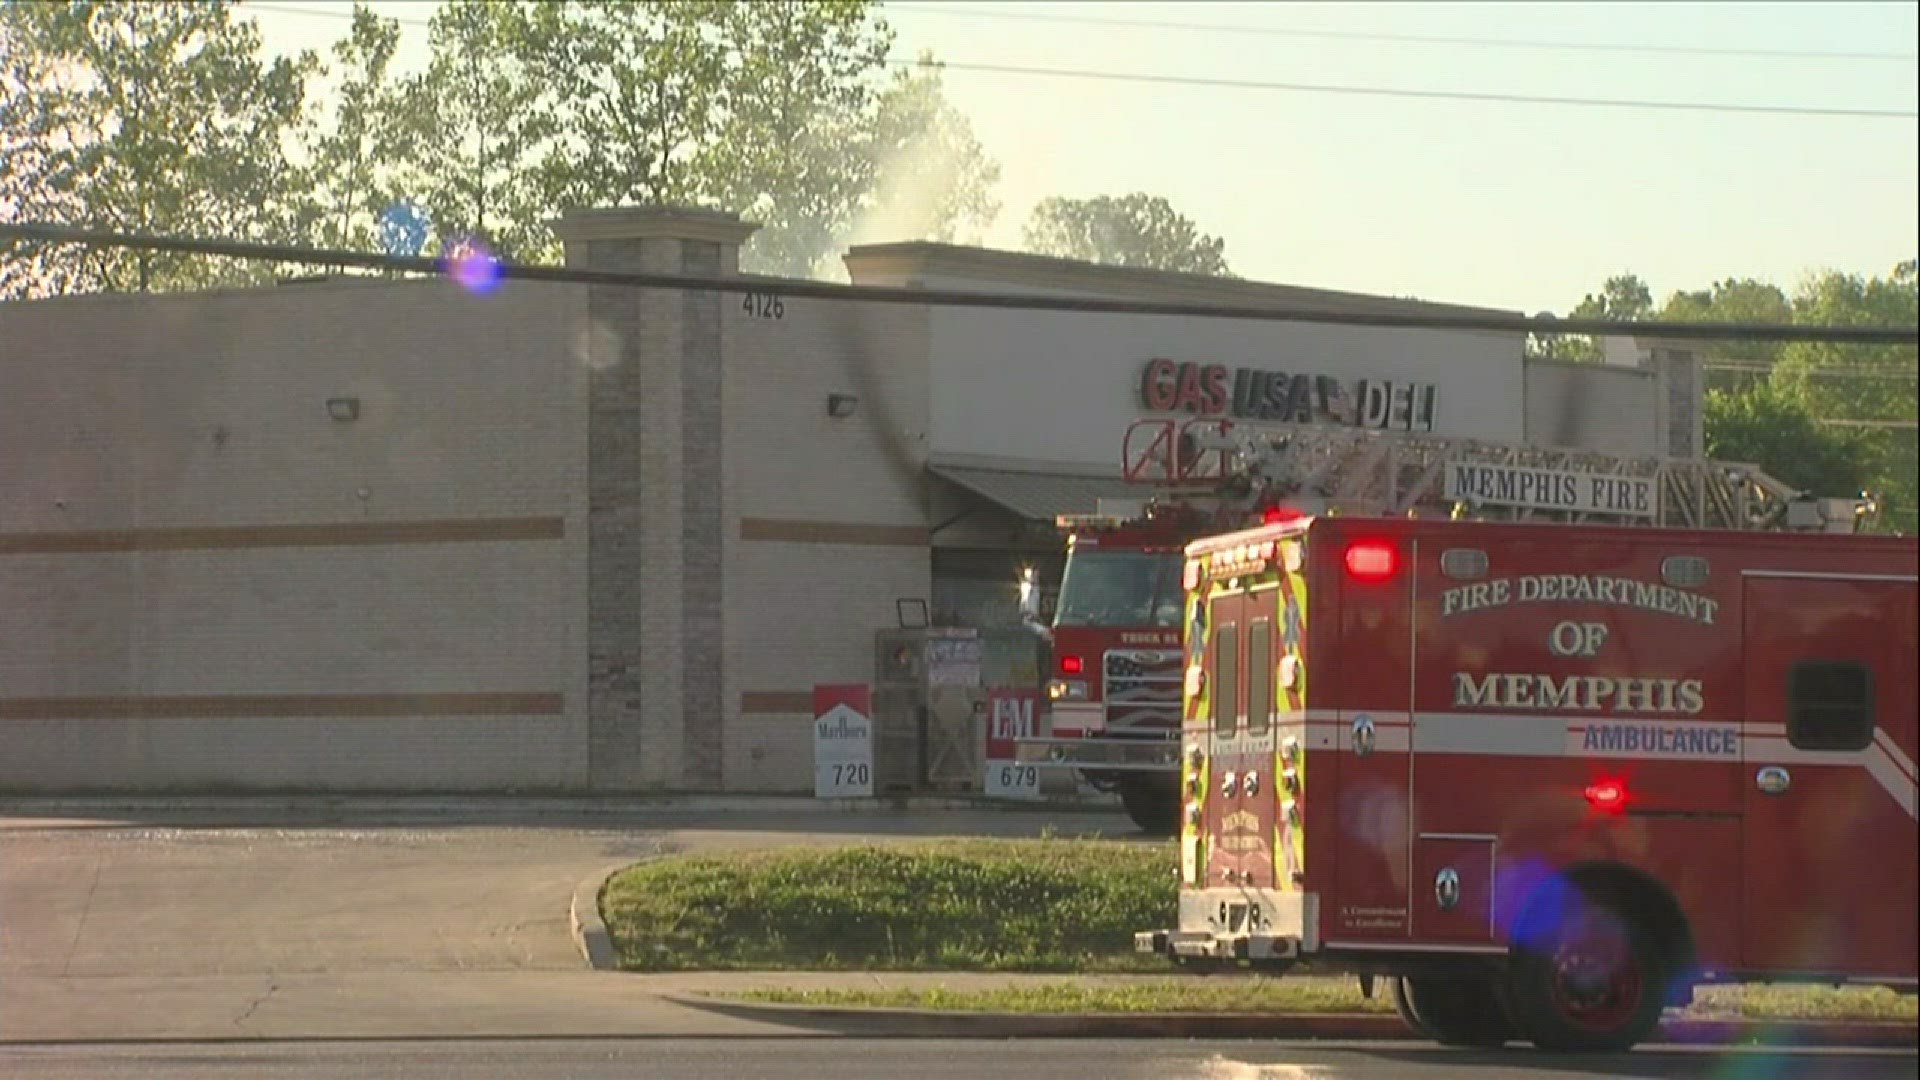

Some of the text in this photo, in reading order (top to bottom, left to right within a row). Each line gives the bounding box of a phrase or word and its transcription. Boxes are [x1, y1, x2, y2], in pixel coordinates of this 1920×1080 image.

[742, 291, 784, 319] 4126
[1141, 358, 1439, 432] GAS USA DELI
[1455, 466, 1649, 512] MEMPHIS FIRE
[1442, 574, 1719, 625] FIRE DEPARTMENT
[1550, 620, 1608, 656] OF
[1454, 671, 1705, 714] MEMPHIS
[1583, 724, 1738, 755] AMBULANCE
[832, 764, 869, 786] 720
[1001, 766, 1037, 788] 679
